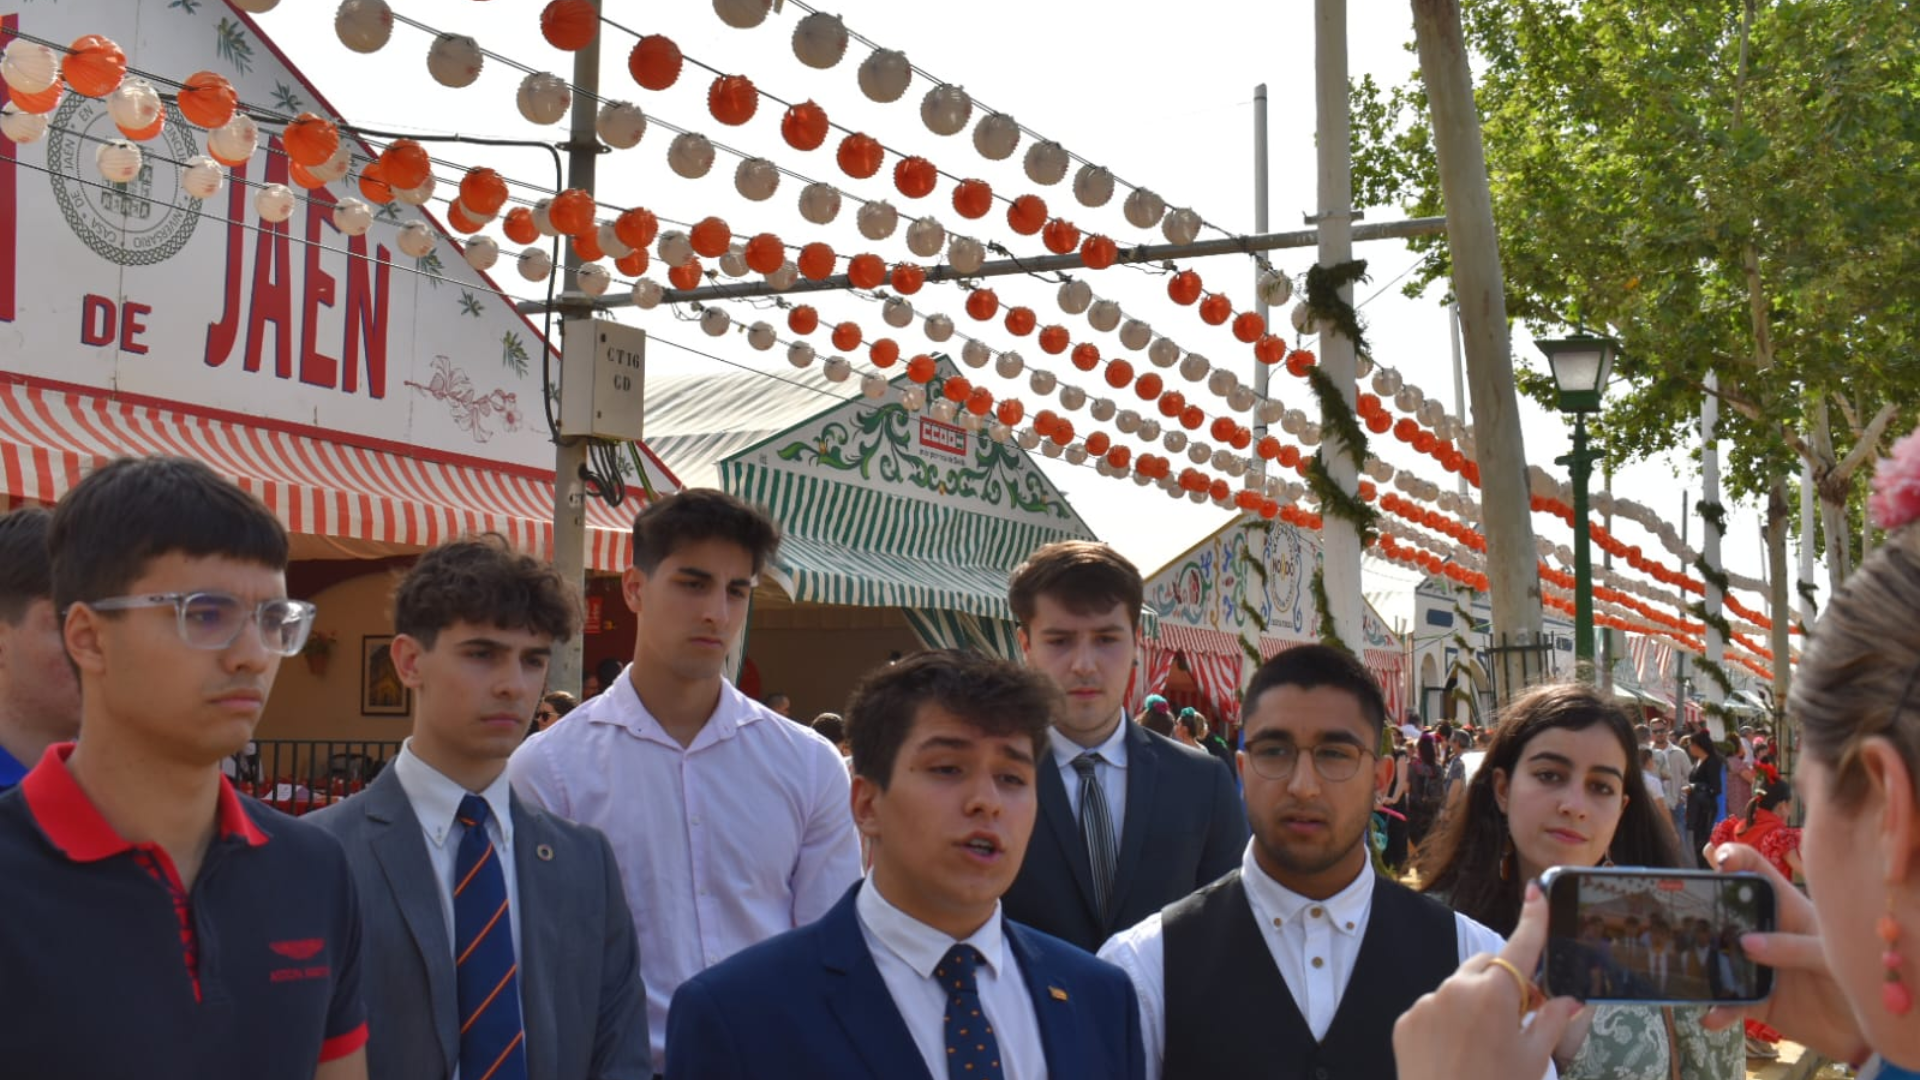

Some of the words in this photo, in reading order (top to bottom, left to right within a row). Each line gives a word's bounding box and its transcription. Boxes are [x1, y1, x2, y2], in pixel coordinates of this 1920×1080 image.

[71, 190, 85, 208] DE
[78, 105, 94, 122] EN
[81, 293, 152, 354] DE
